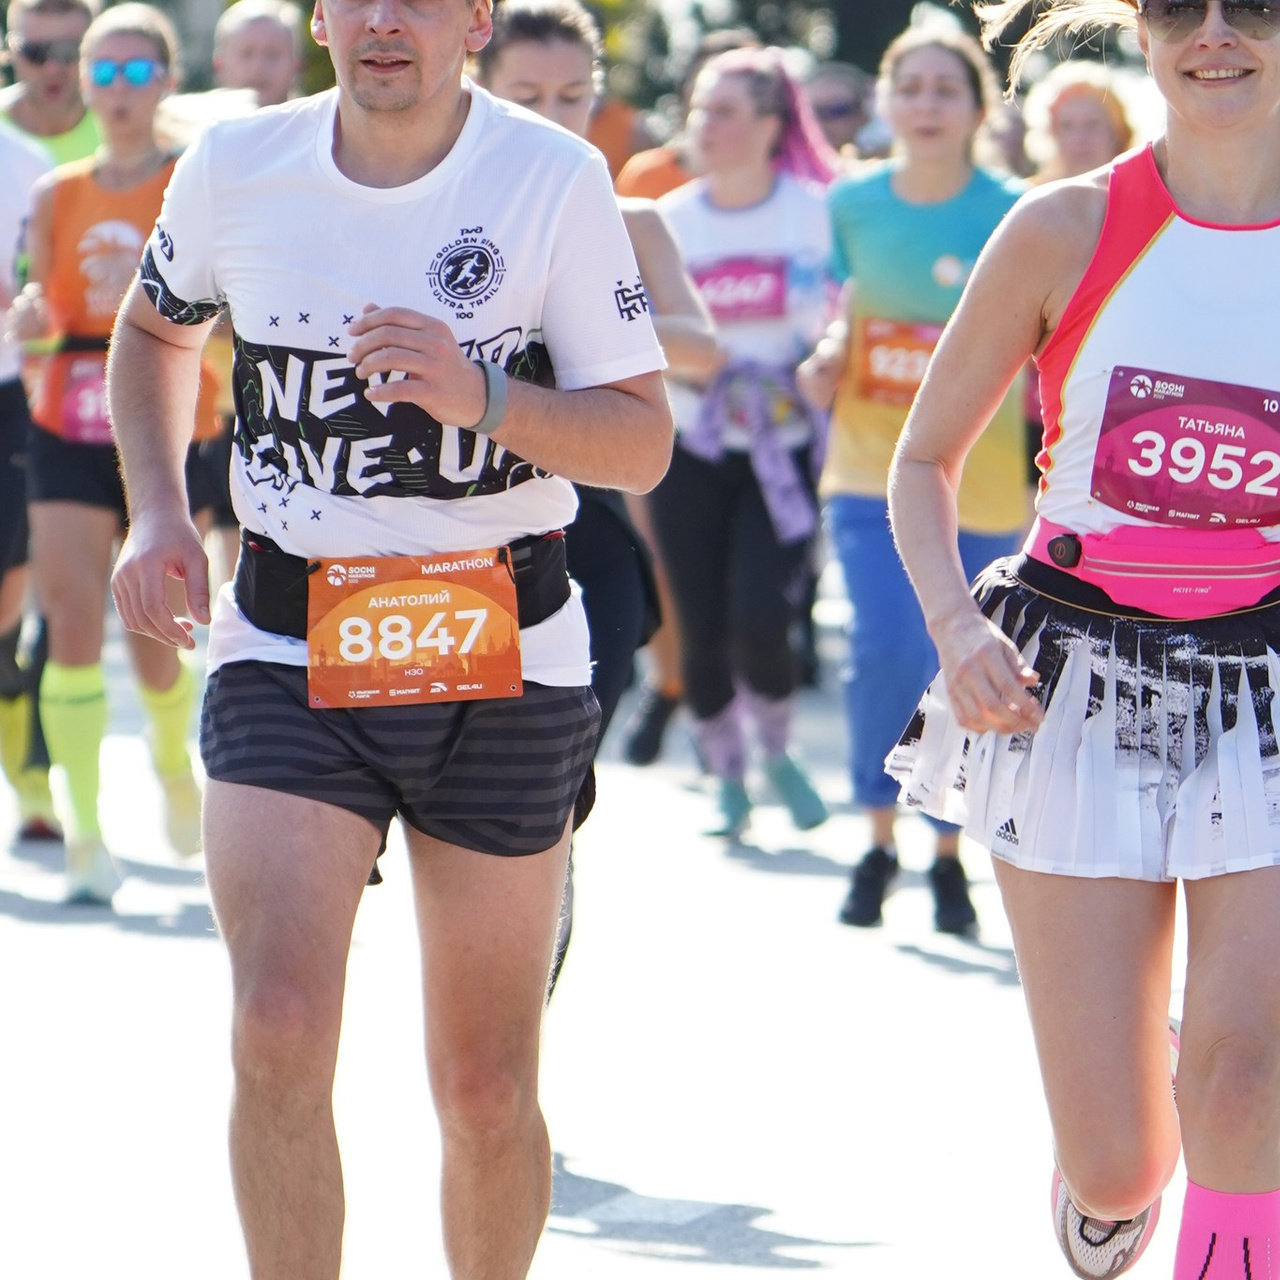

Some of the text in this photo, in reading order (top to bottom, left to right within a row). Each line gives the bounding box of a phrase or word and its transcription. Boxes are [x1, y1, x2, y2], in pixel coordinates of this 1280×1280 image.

[436, 237, 500, 259] GOLDEN RING
[432, 287, 500, 310] ULTRA TRAIL
[455, 311, 474, 320] 100
[1263, 399, 1279, 413] 10
[1178, 415, 1246, 440] ТАТЬЯНА
[348, 566, 375, 574] SOCHI
[421, 557, 494, 575] MARATHON
[368, 589, 450, 609] АНАТОЛИЙ
[338, 608, 488, 663] 8847
[396, 687, 421, 696] МАГНИТ
[995, 830, 1020, 846] adidas
